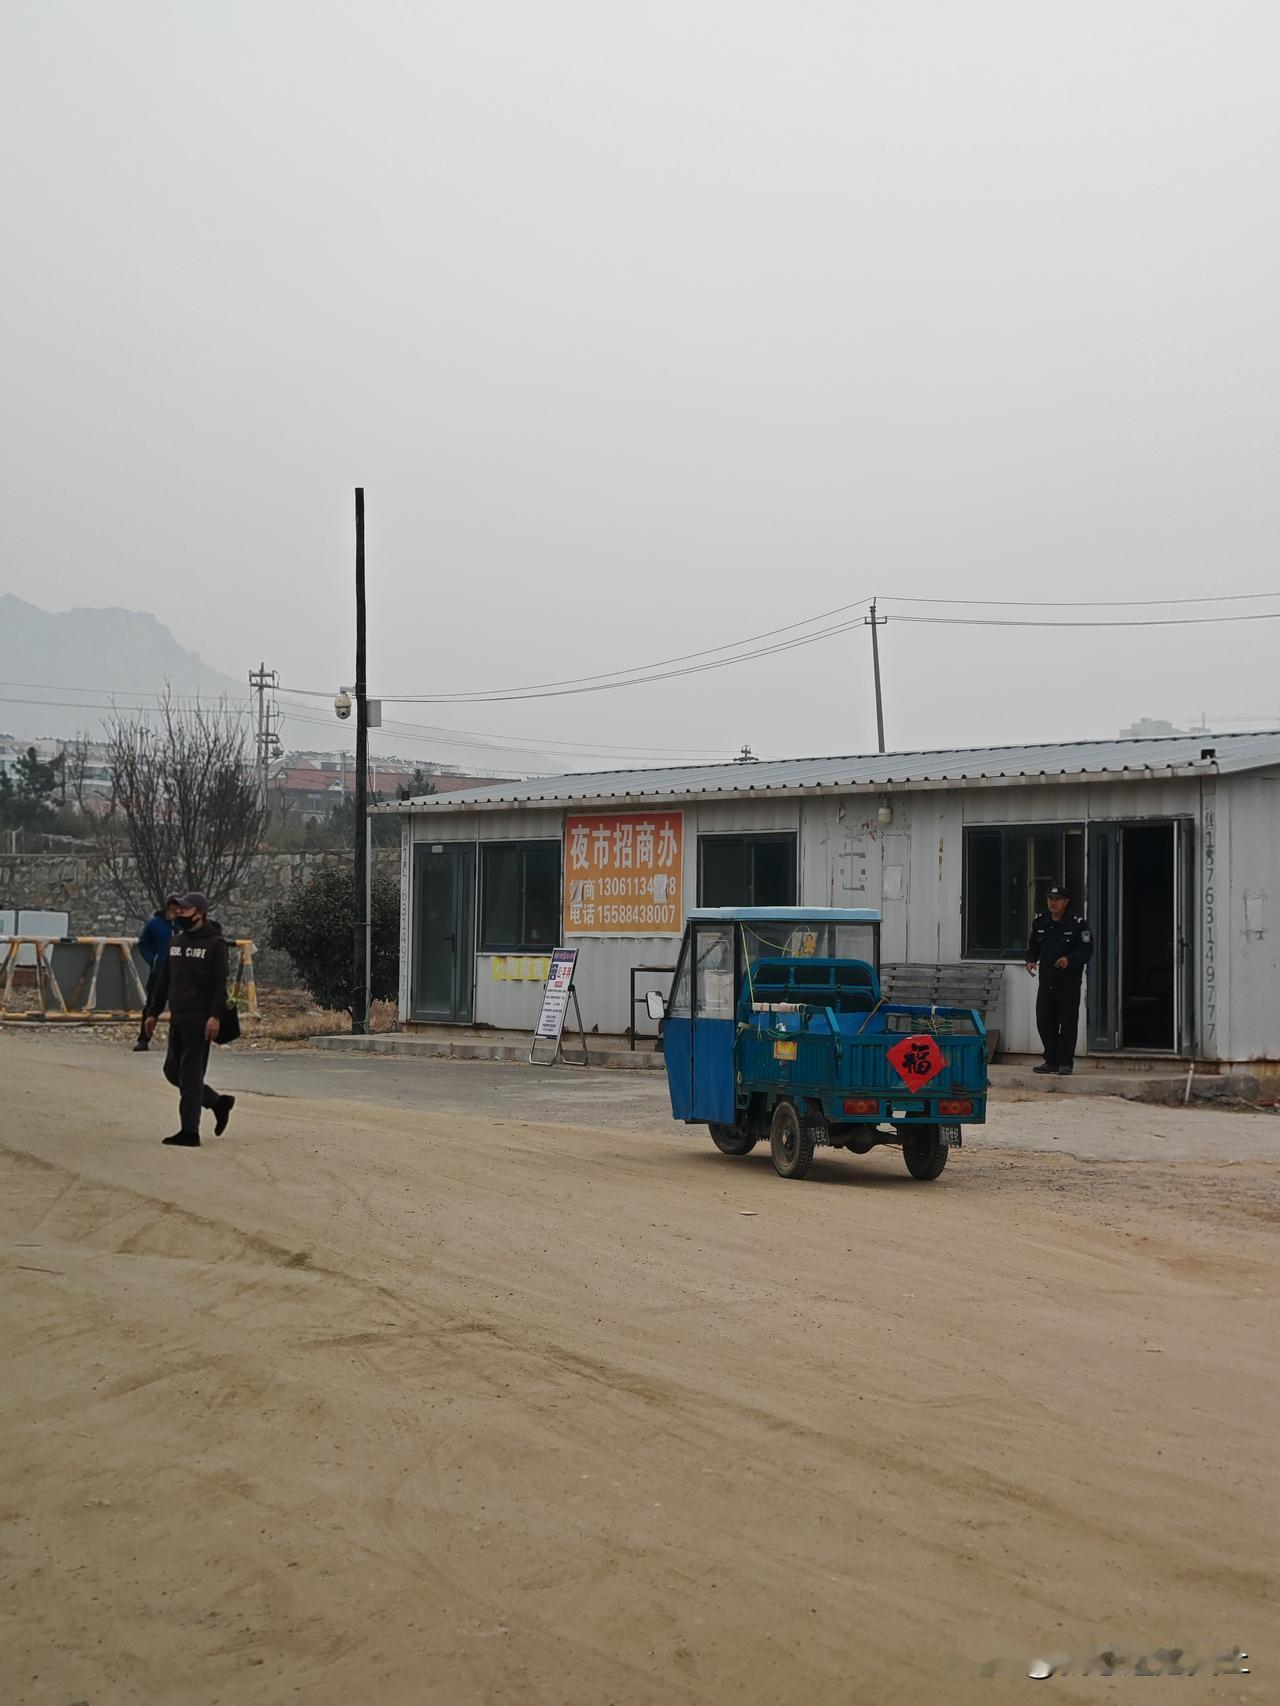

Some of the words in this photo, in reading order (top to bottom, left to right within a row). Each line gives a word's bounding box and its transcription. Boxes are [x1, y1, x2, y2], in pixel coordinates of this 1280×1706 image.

[570, 820, 678, 871] 夜市招商办
[598, 876, 676, 897] 130611348
[570, 903, 595, 925] 电话
[598, 905, 676, 924] 15588438007
[902, 1043, 932, 1075] 福
